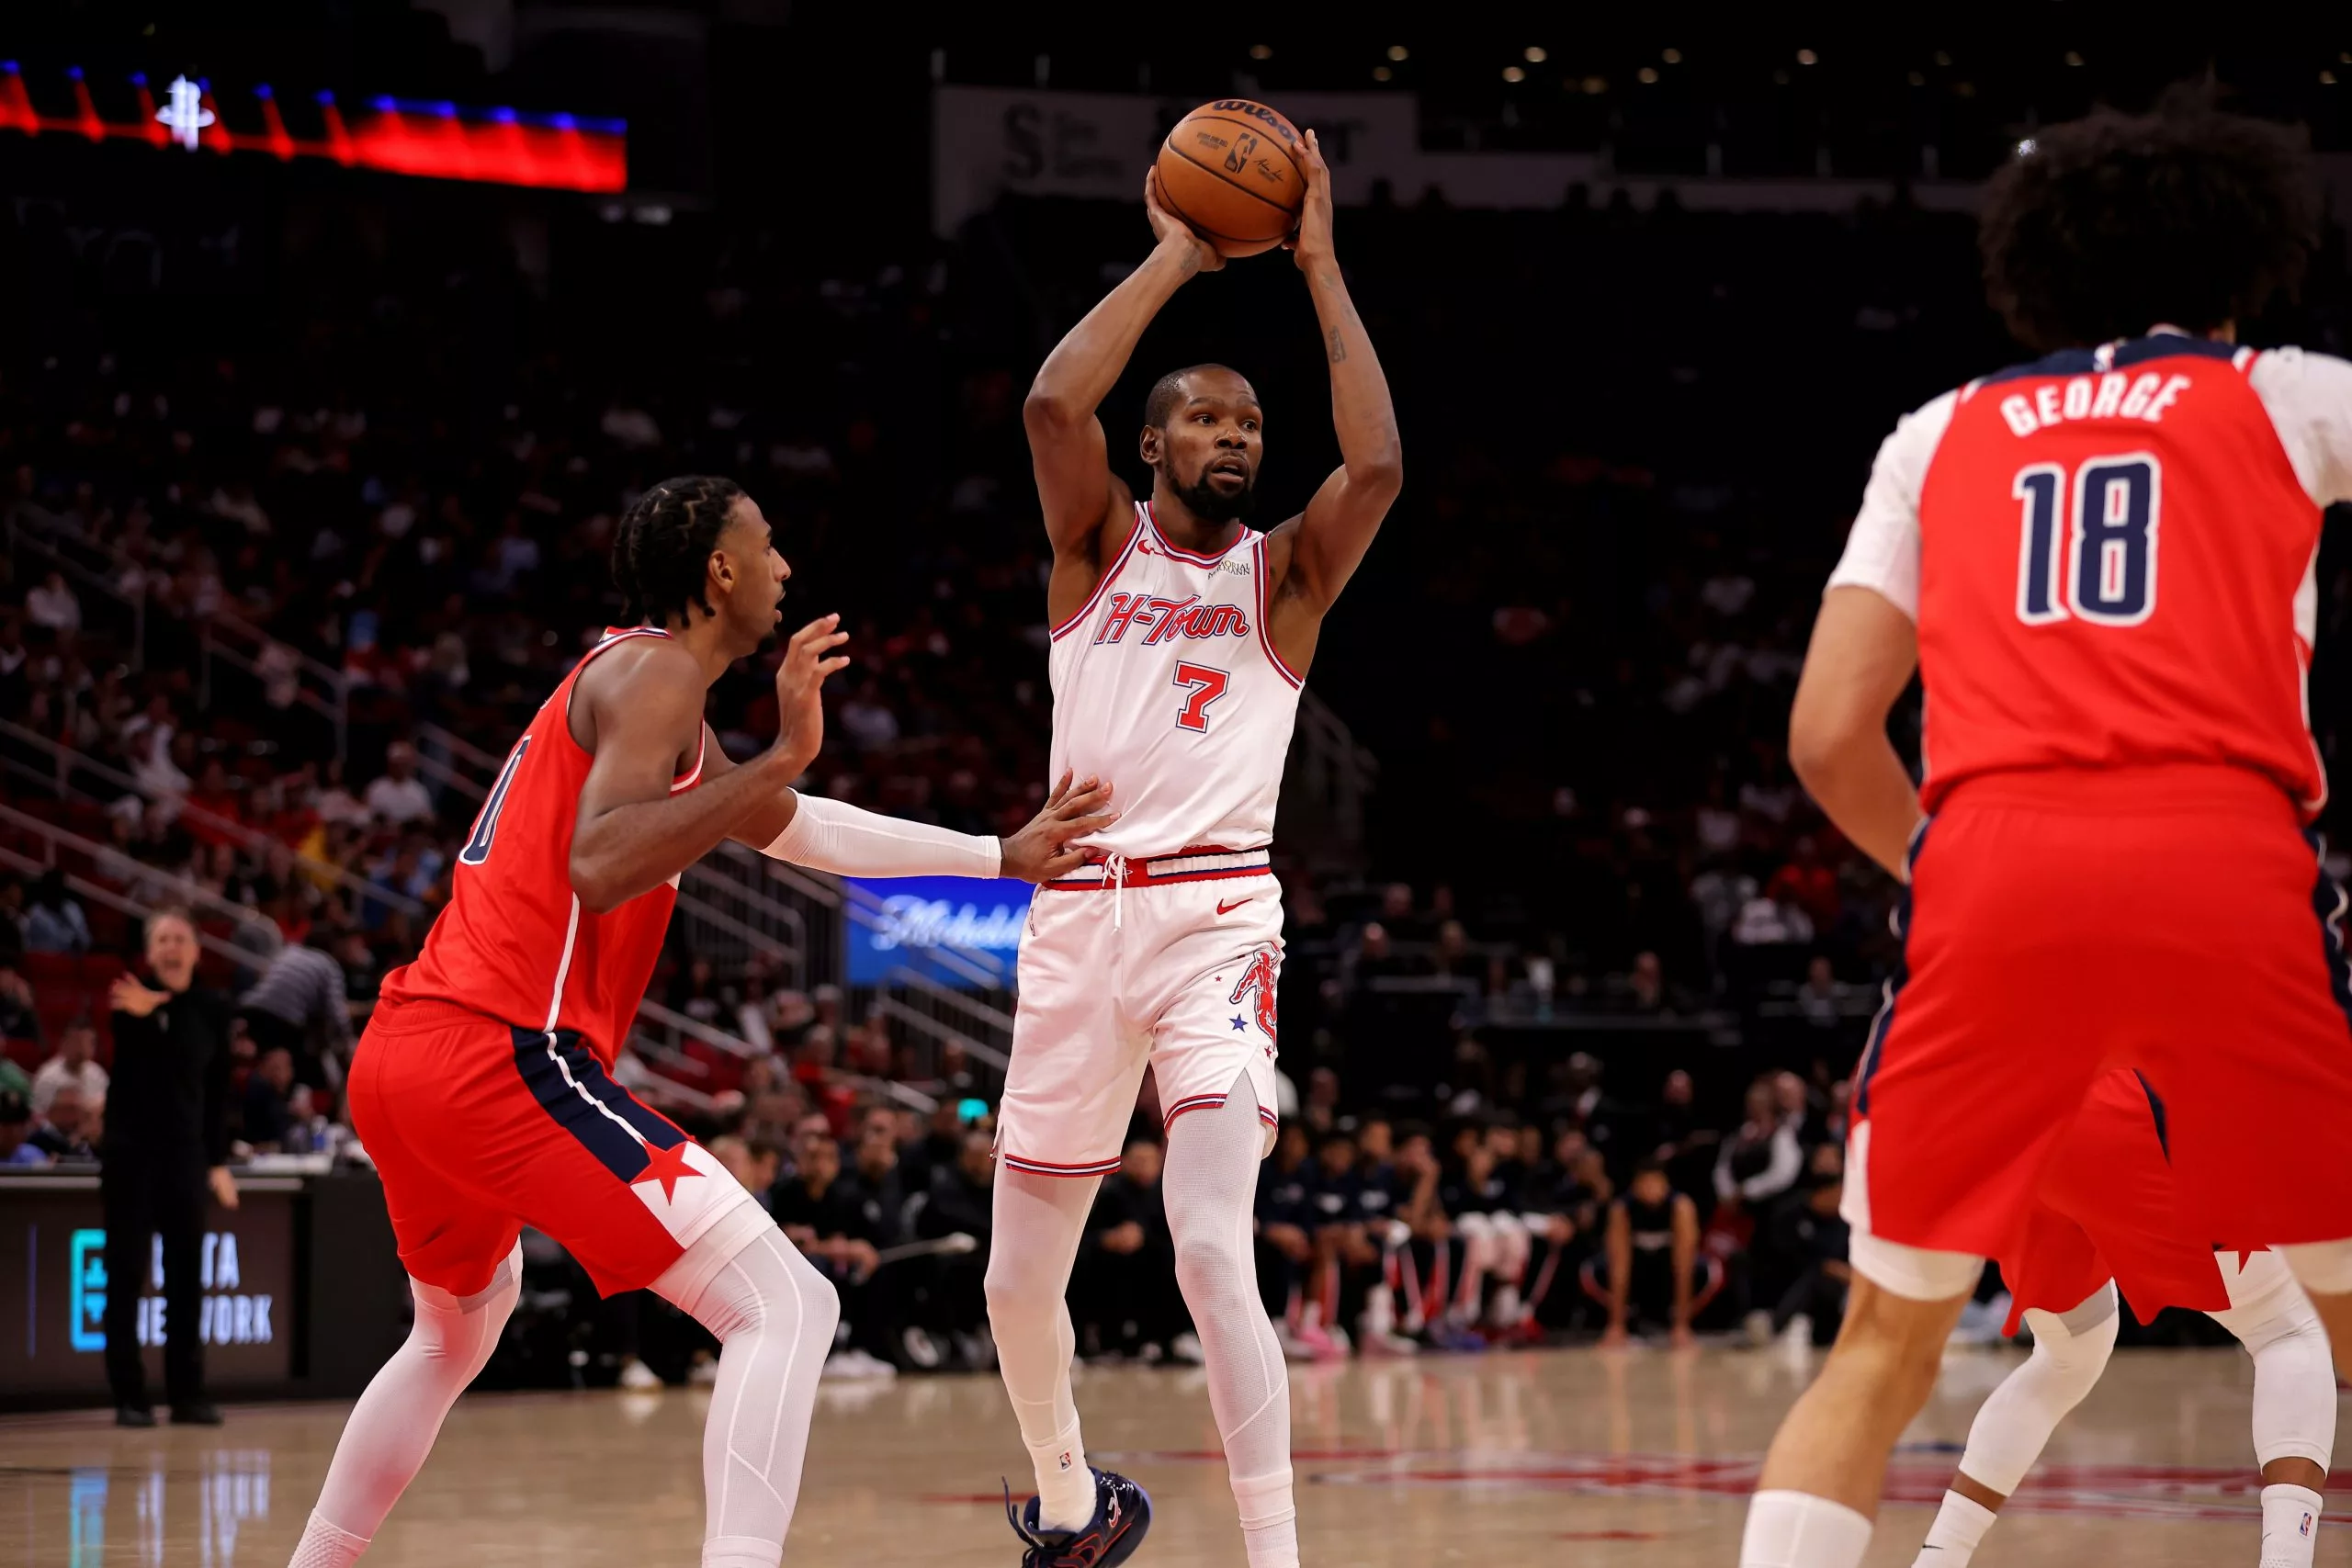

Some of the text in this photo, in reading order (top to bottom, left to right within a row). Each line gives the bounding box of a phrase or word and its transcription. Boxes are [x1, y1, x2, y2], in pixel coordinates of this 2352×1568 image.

[1999, 371, 2192, 438] GEORGE
[2011, 450, 2163, 627] 18
[1093, 593, 1250, 646] H-Town
[1172, 660, 1230, 733] 7
